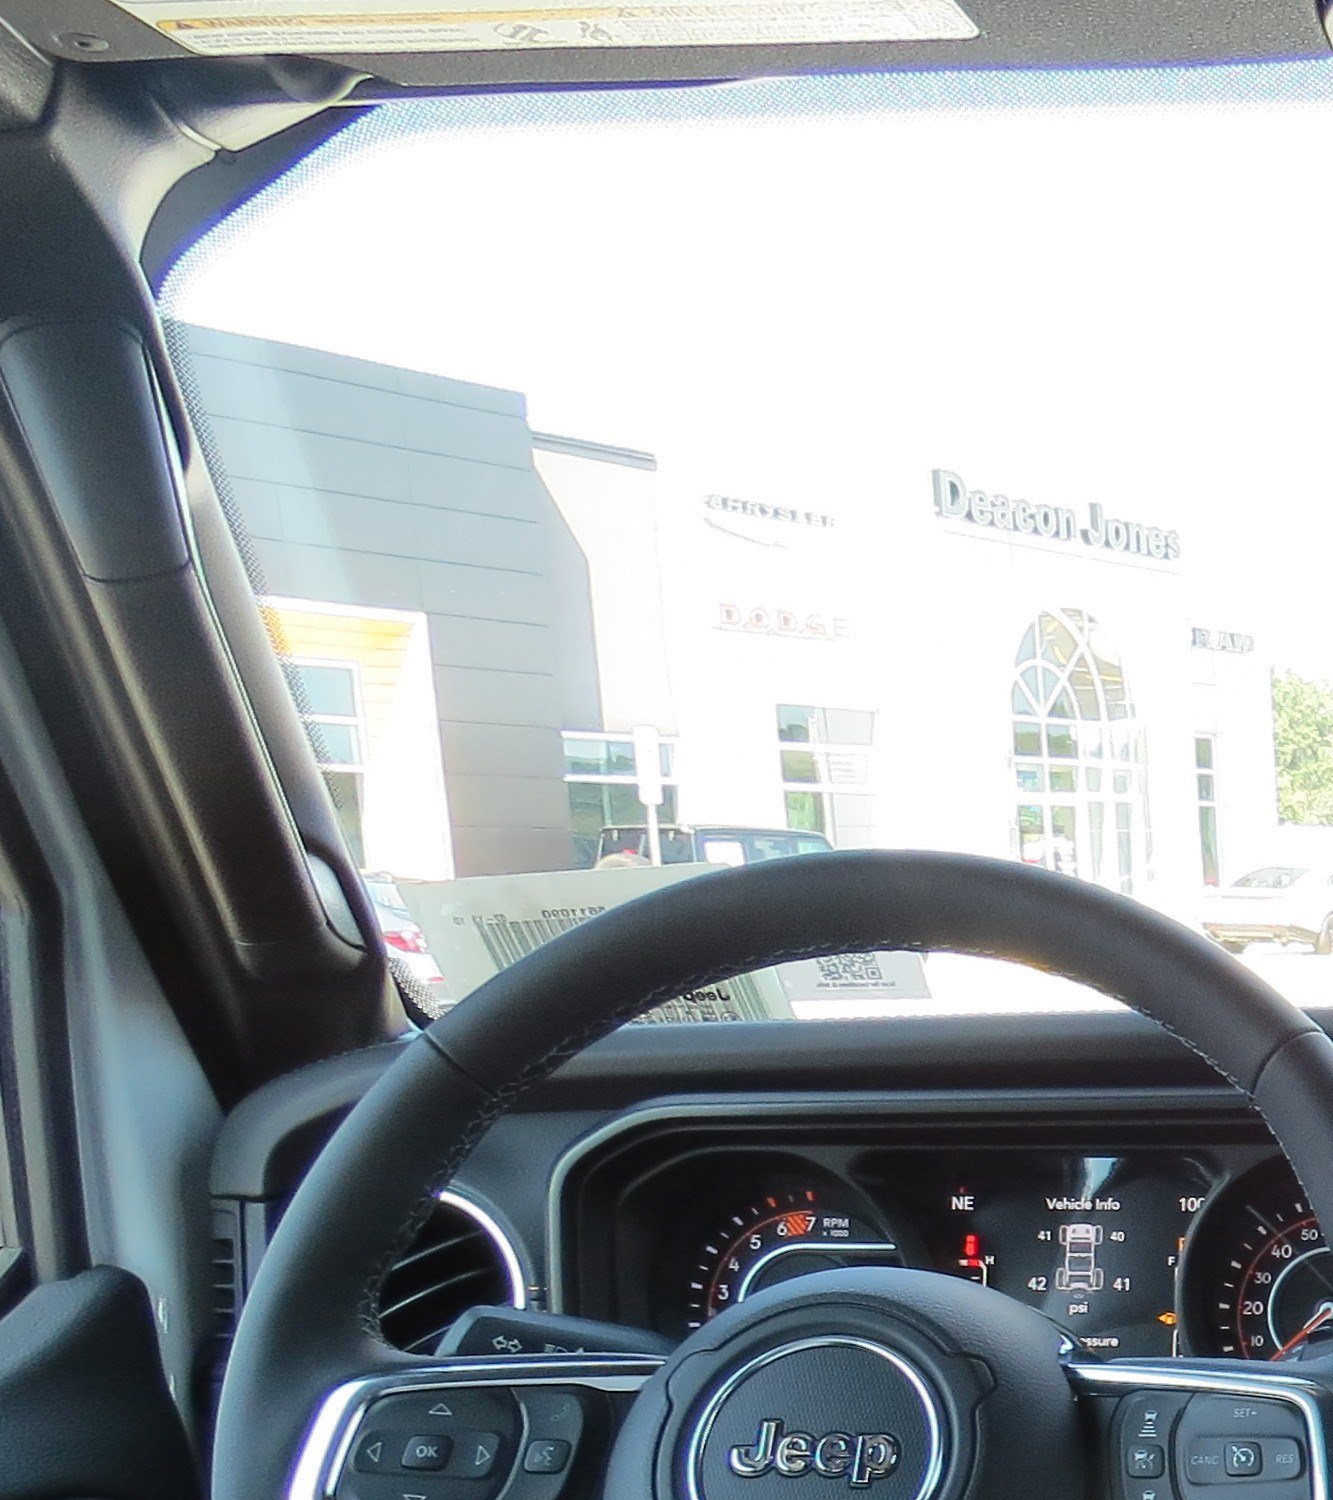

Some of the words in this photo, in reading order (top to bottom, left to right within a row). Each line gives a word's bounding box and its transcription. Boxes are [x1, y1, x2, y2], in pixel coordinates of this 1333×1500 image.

[930, 467, 1078, 541] Deacon
[1080, 501, 1182, 561] Jones
[718, 602, 850, 638] DODGE
[1191, 625, 1256, 654] RAM
[950, 1196, 976, 1211] NE
[1045, 1197, 1093, 1211] Vehicle
[1095, 1197, 1121, 1211] Info
[777, 1220, 787, 1237] 6
[804, 1216, 817, 1233] 7
[823, 1217, 850, 1228] RPM
[749, 1233, 762, 1250] 5
[1037, 1230, 1052, 1242] 41
[1109, 1230, 1126, 1243] 40
[1300, 1229, 1319, 1241] 50
[1270, 1244, 1292, 1259] 40
[728, 1256, 740, 1273] 4
[984, 1256, 996, 1266] H
[1167, 1256, 1176, 1267] F
[1027, 1276, 1048, 1291] 42
[1112, 1277, 1130, 1292] 41
[1254, 1272, 1272, 1284] 30
[718, 1285, 729, 1301] 3
[1068, 1301, 1089, 1316] psi
[1242, 1301, 1264, 1315] 20
[1250, 1335, 1264, 1347] 10
[414, 1445, 438, 1459] OK
[728, 1419, 901, 1489] Jeep
[1275, 1453, 1295, 1465] RES
[1190, 1454, 1219, 1466] CANC
